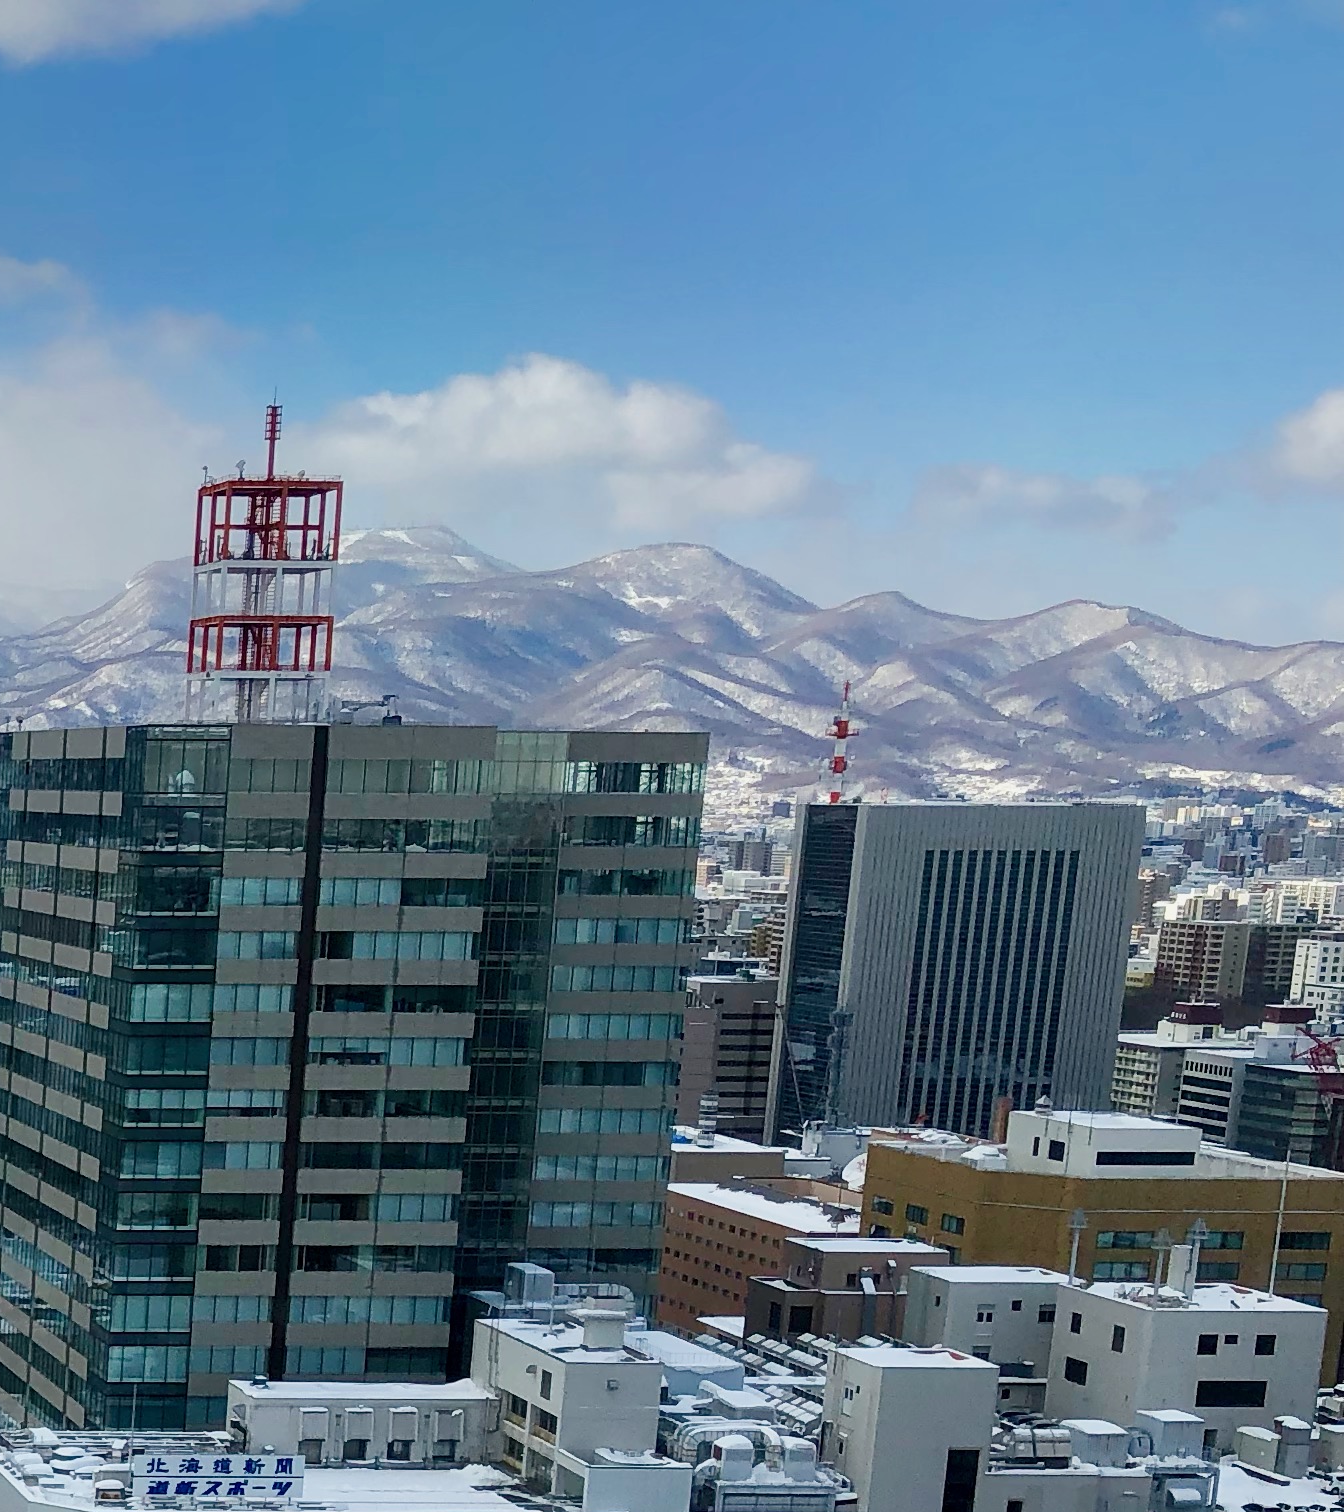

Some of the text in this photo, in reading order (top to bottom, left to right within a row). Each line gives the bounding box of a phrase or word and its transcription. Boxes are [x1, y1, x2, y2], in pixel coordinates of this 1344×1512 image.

[146, 1457, 294, 1474] 北海道新聞
[145, 1480, 293, 1496] 道新スポーツ
